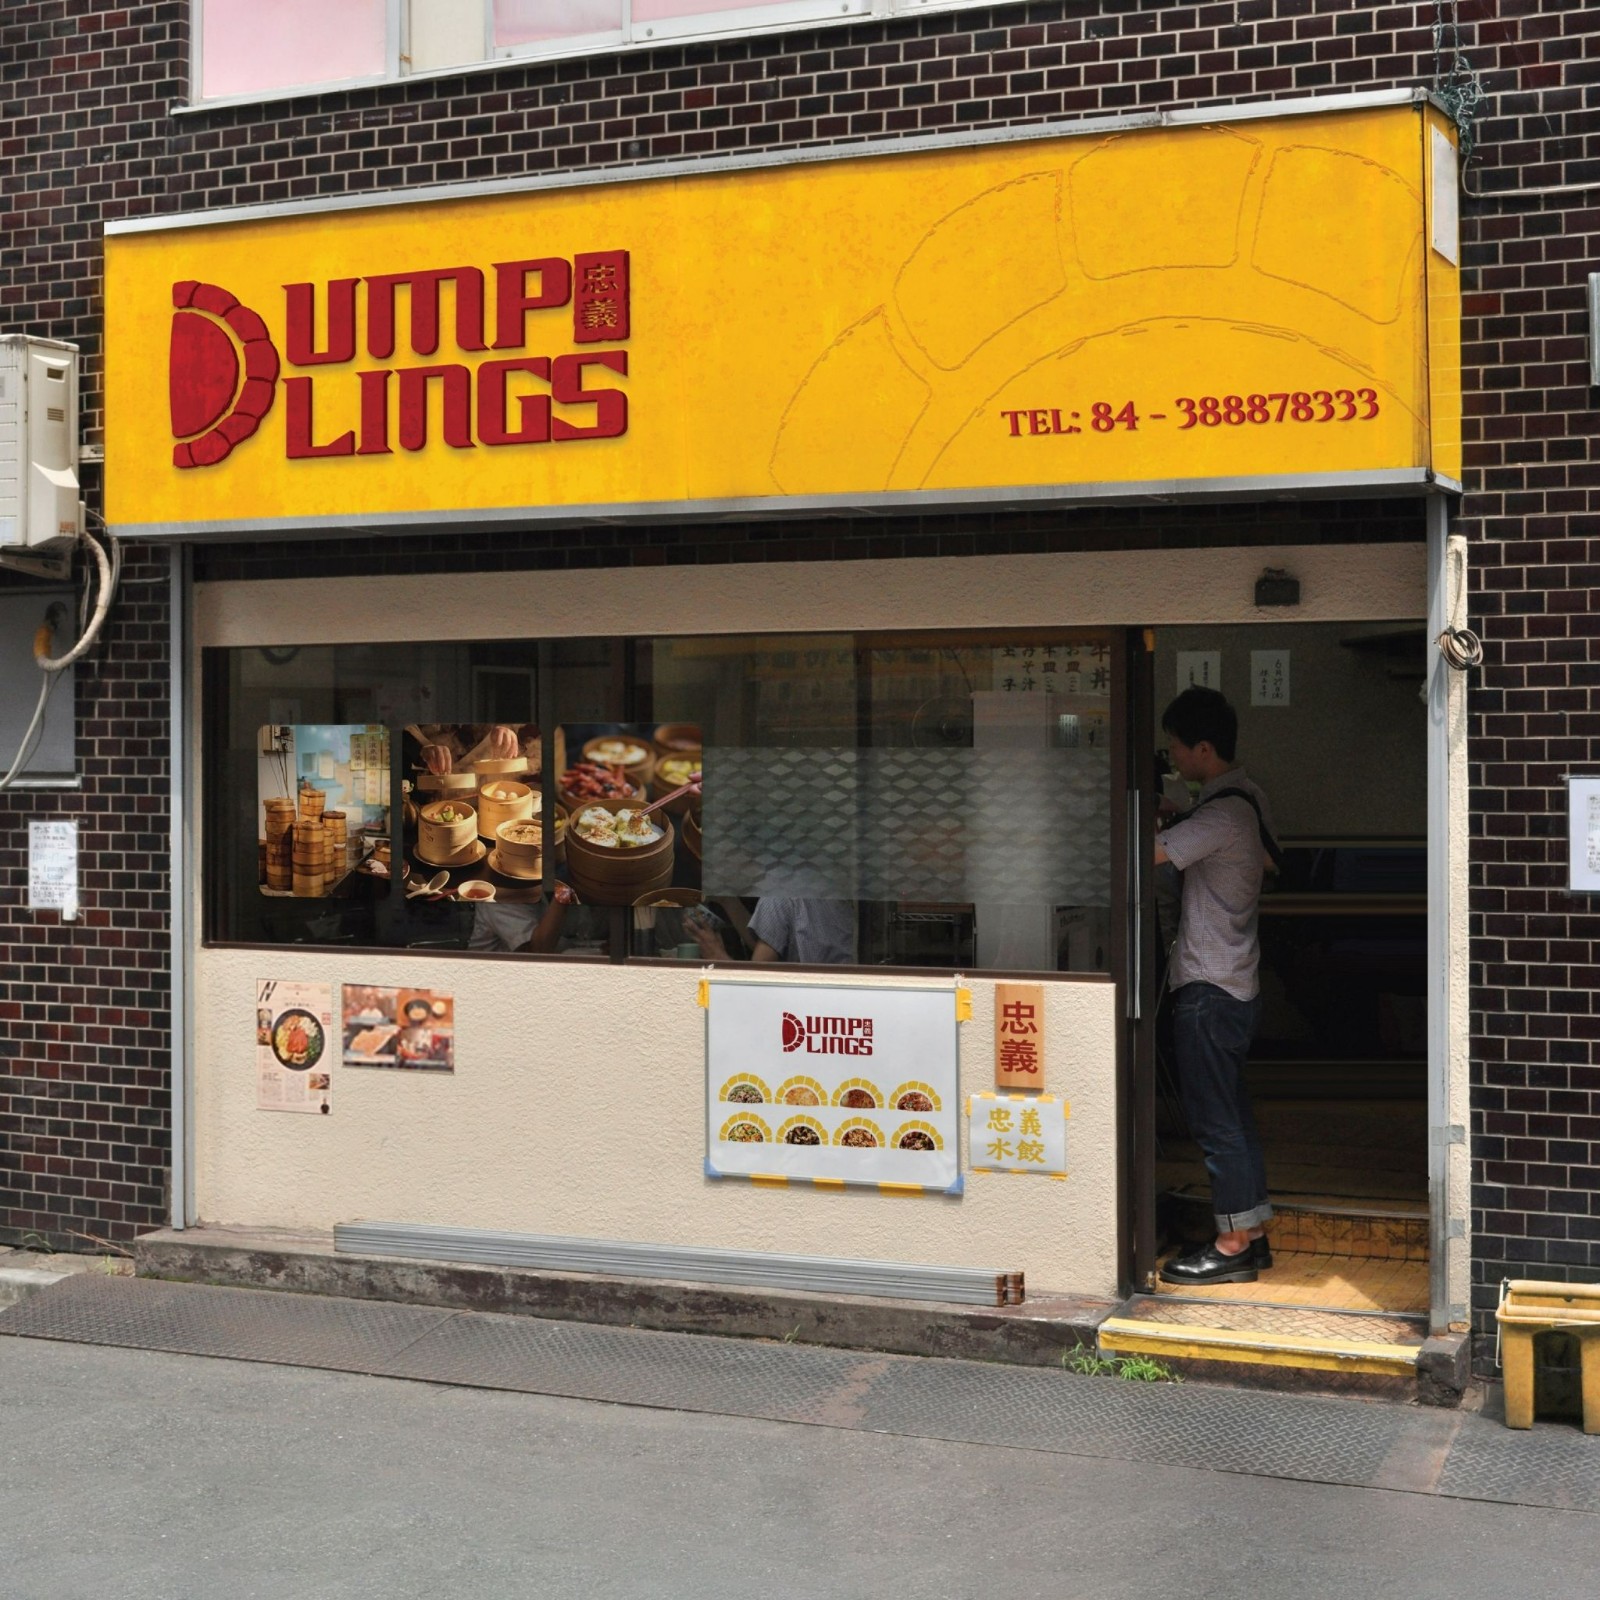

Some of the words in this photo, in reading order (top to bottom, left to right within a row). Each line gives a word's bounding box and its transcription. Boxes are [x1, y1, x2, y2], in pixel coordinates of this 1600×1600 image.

[581, 262, 618, 330] 忠義
[281, 350, 629, 459] LINGS
[1001, 408, 1081, 437] TEL:
[1091, 400, 1140, 433] 84
[1175, 387, 1381, 430] 388878333
[806, 1036, 872, 1056] LINGS
[1000, 1001, 1038, 1074] 忠義
[986, 1107, 1042, 1137] 忠義
[986, 1137, 1046, 1164] 水餃
